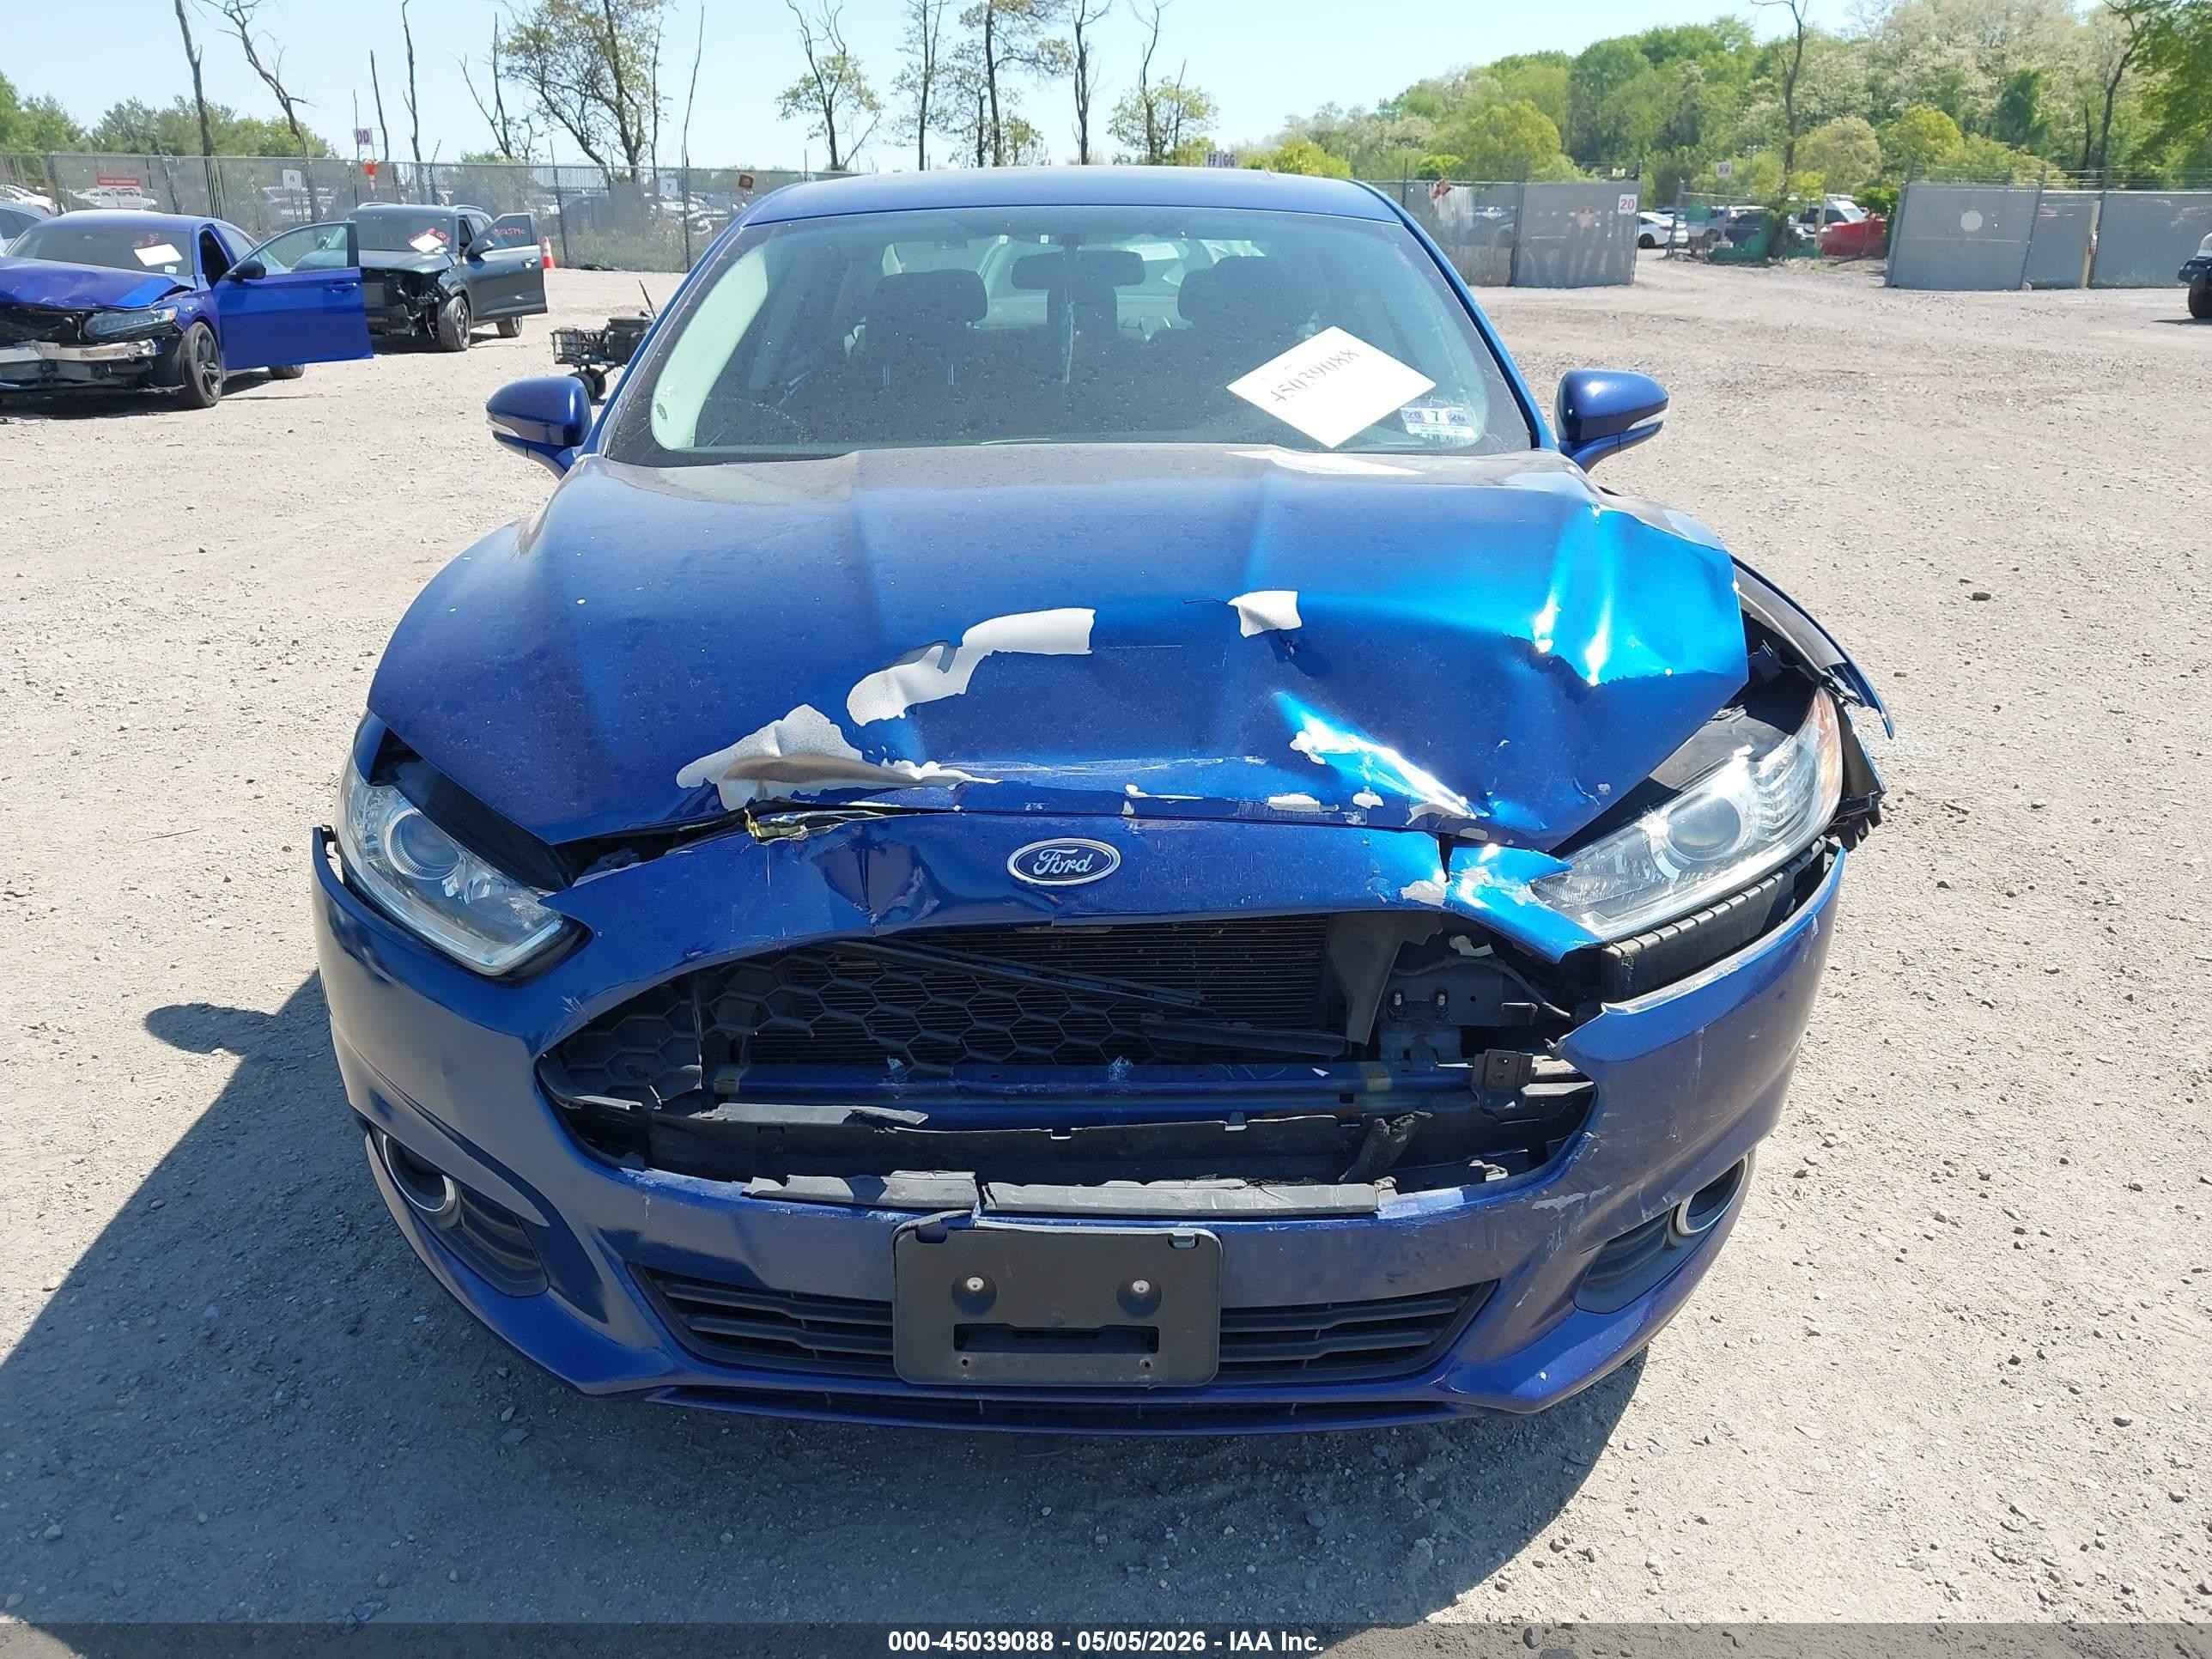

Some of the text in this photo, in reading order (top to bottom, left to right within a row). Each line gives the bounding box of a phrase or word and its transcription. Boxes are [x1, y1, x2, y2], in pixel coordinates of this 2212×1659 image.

[1620, 198, 1635, 210] 20
[1270, 349, 1360, 402] 45039088
[1430, 410, 1438, 422] 7
[1449, 413, 1465, 422] 26
[1033, 848, 1094, 875] Ford
